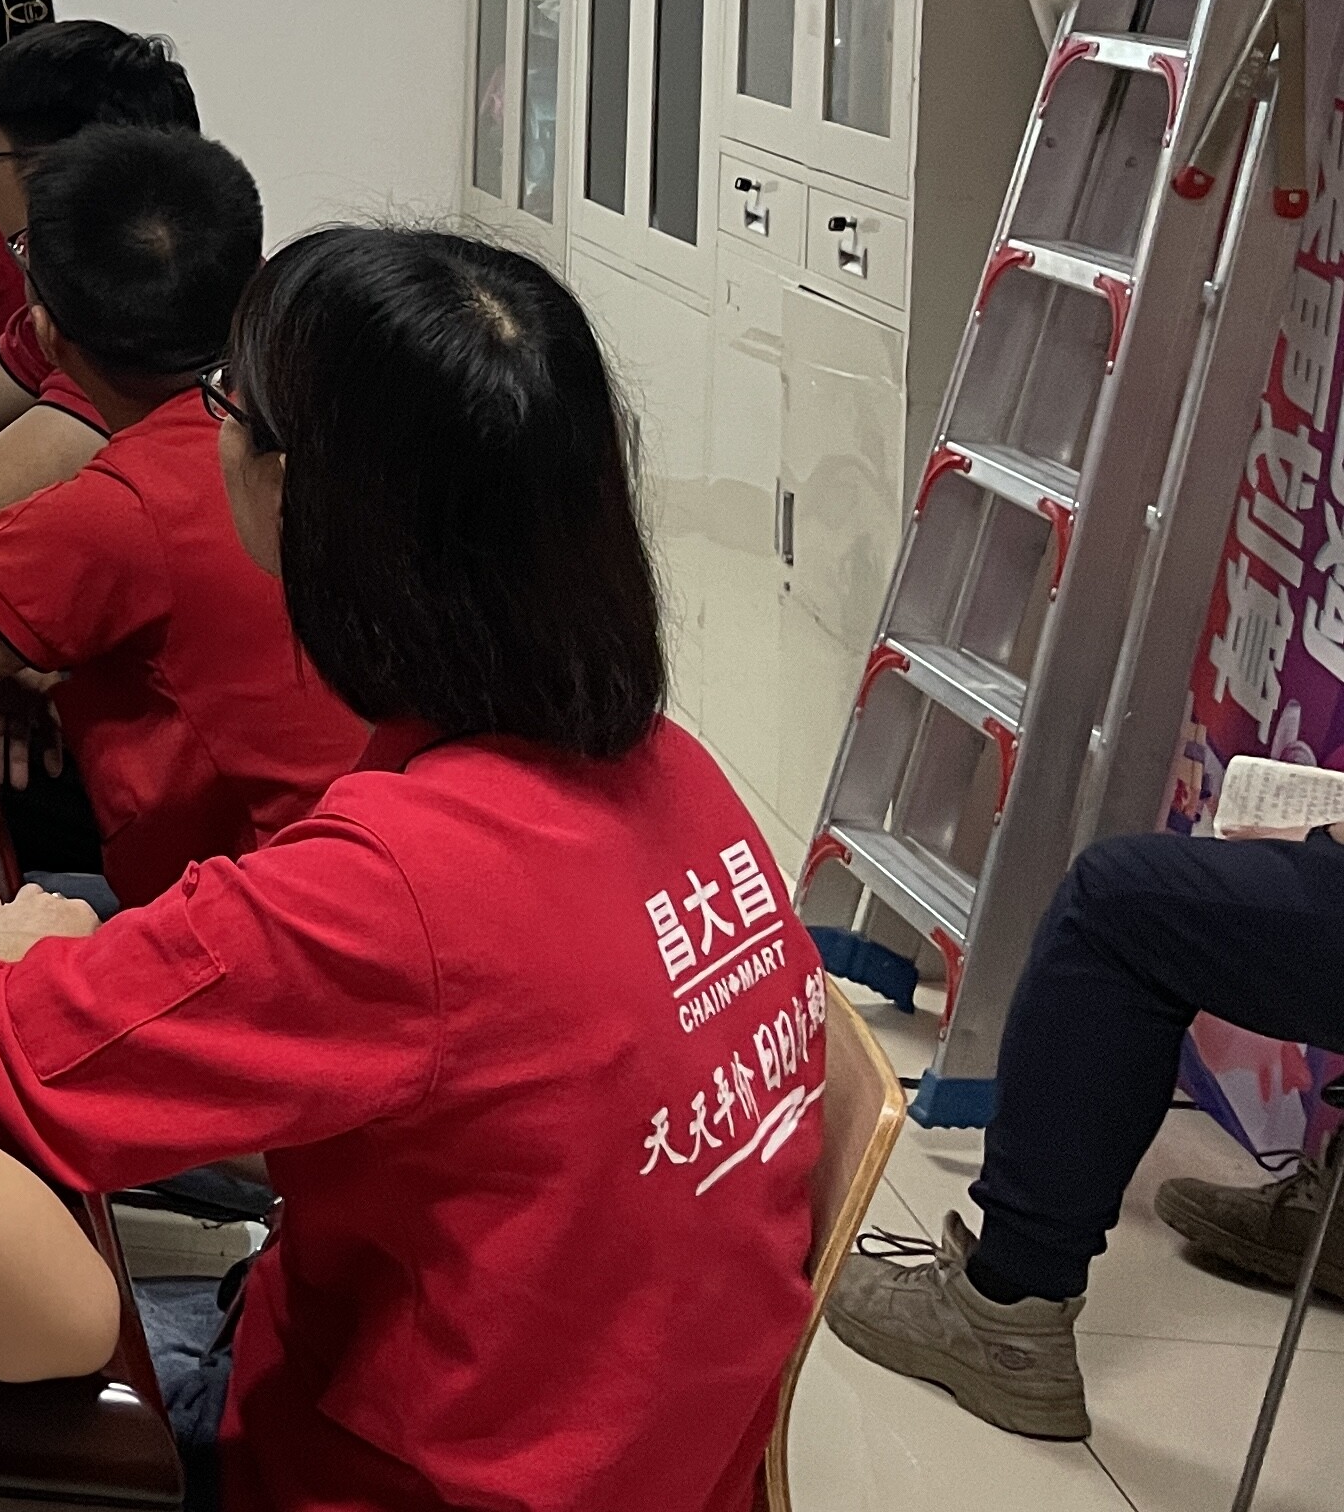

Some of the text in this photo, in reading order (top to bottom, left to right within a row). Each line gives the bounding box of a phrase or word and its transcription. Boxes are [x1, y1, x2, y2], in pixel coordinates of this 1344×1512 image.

[645, 839, 777, 982] 昌大昌
[678, 938, 787, 1034] CHAIN MART
